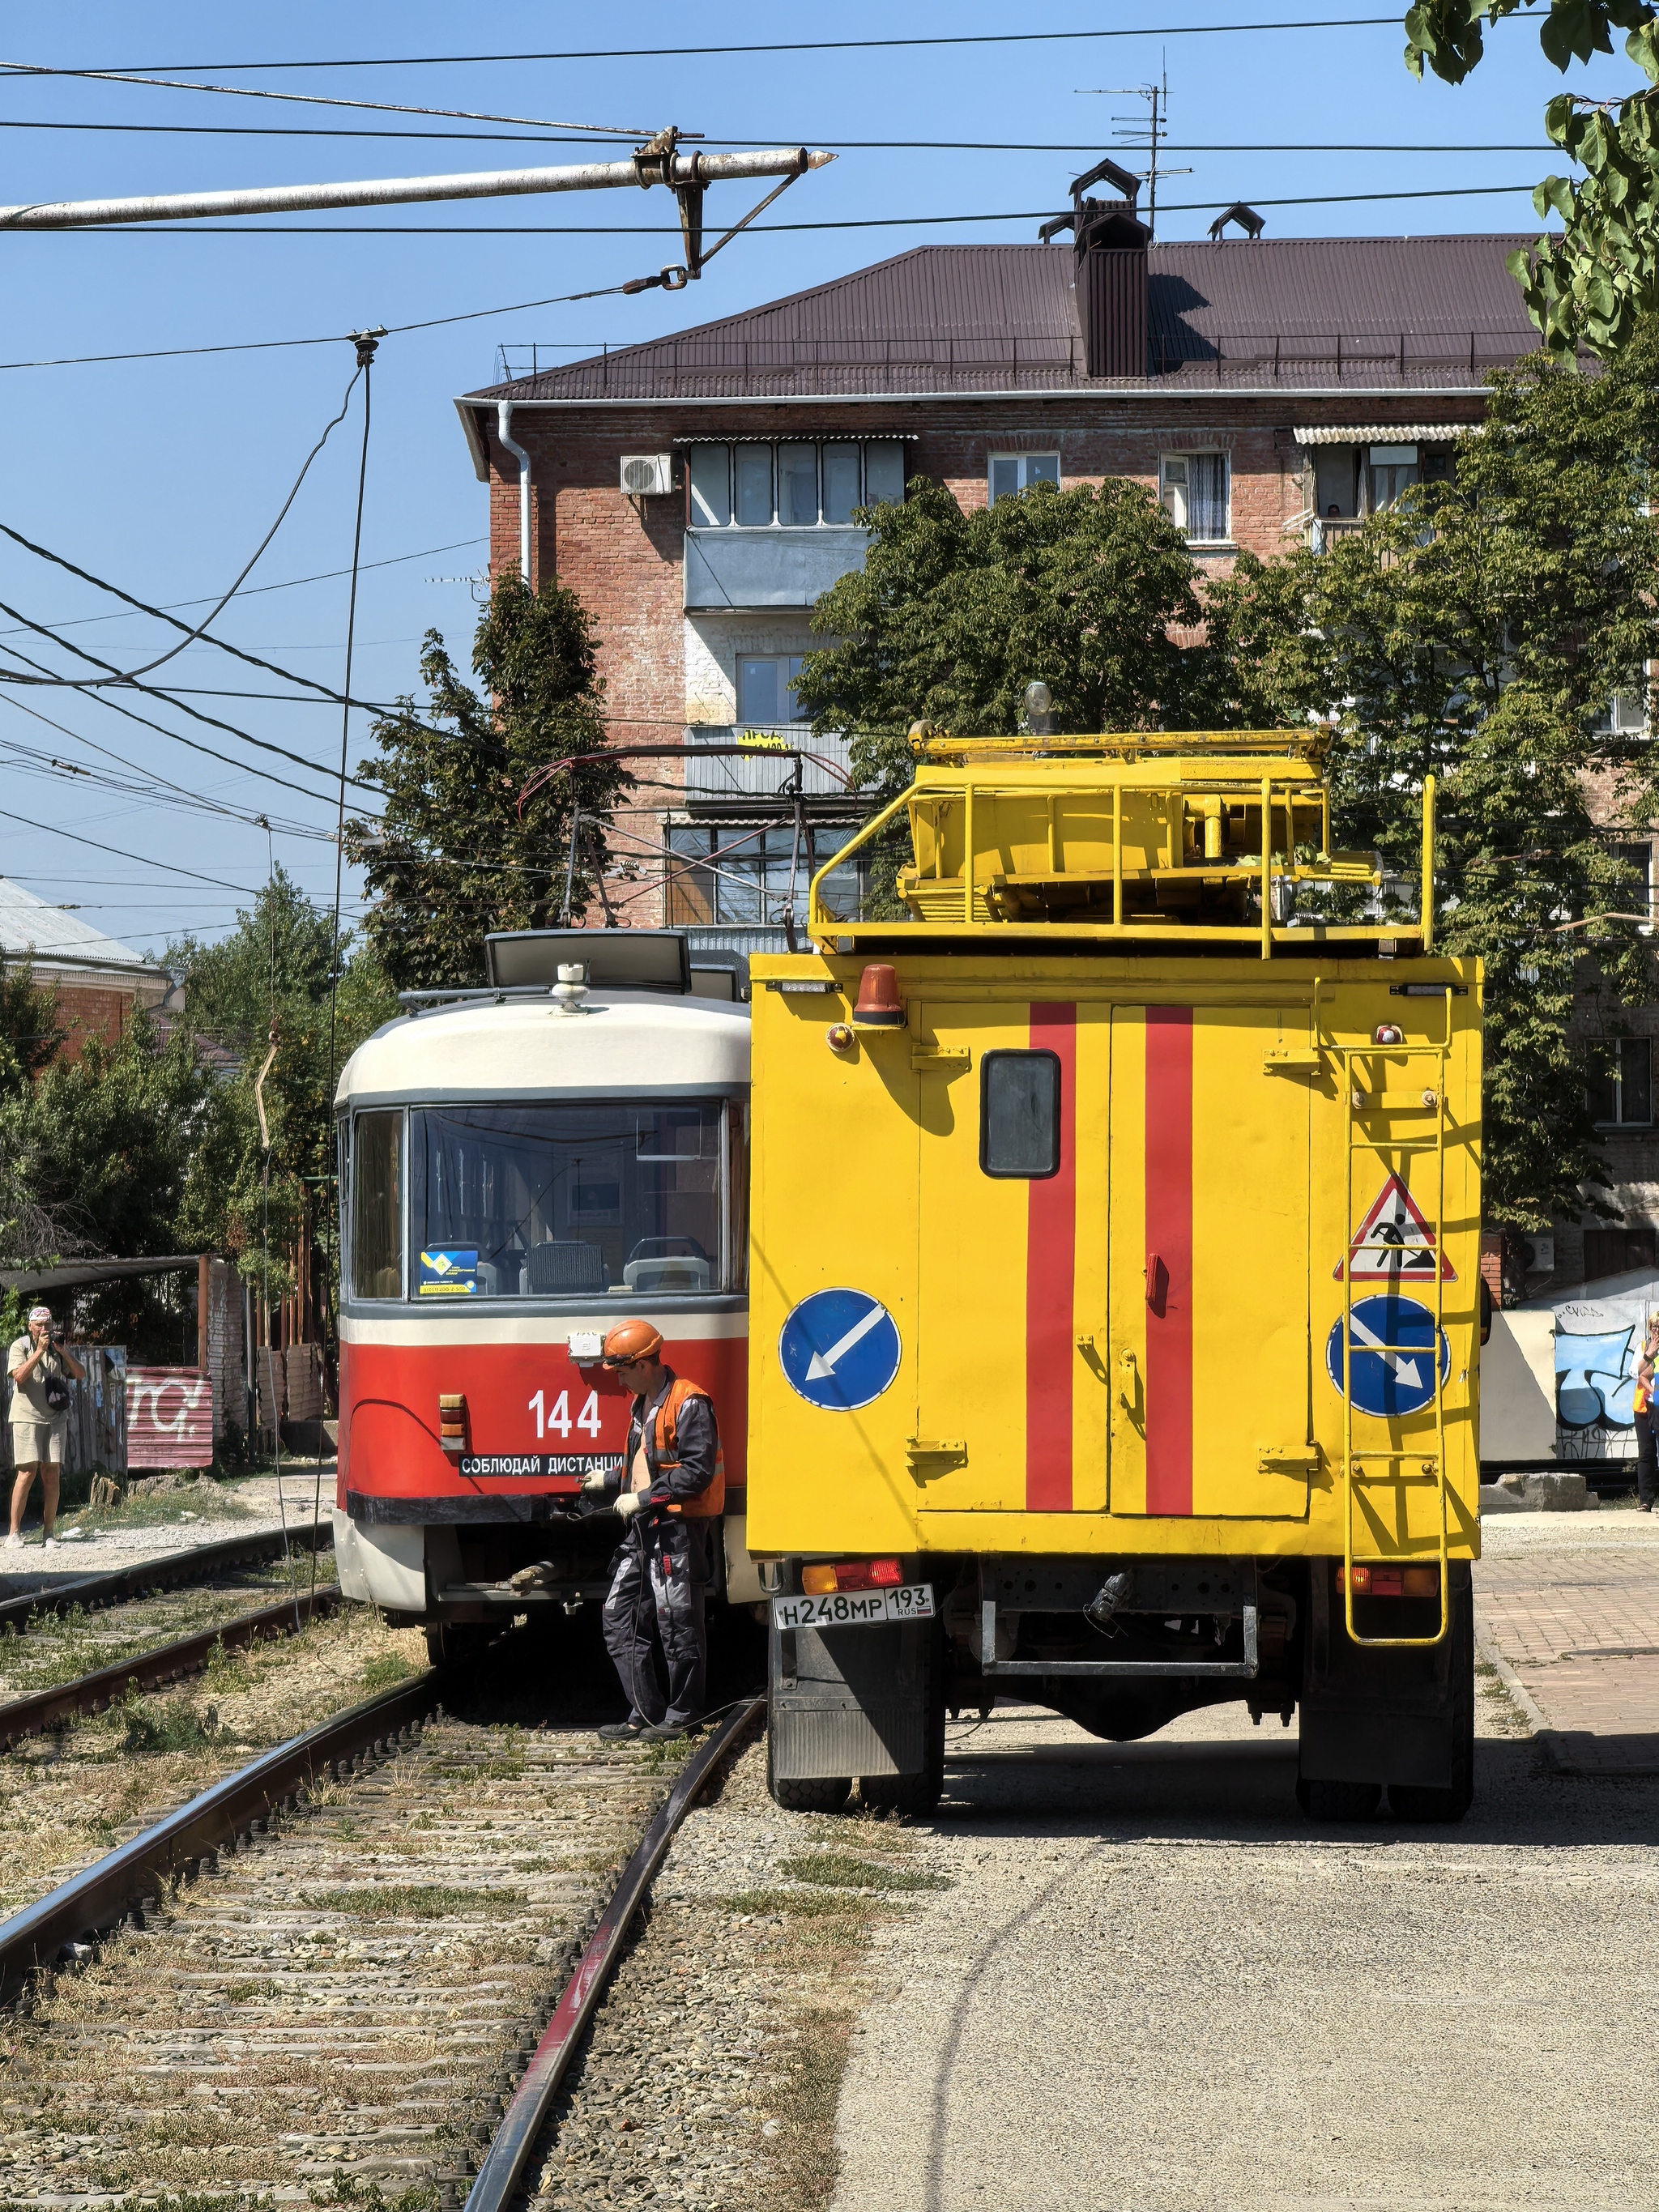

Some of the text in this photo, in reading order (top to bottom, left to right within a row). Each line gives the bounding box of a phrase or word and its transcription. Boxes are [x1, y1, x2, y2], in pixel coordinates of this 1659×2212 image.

[528, 1389, 602, 1438] 144
[462, 1455, 540, 1476] СОБЛЮДАЙ
[784, 1587, 925, 1625] Н248МР 193
[898, 1606, 917, 1616] RUS
